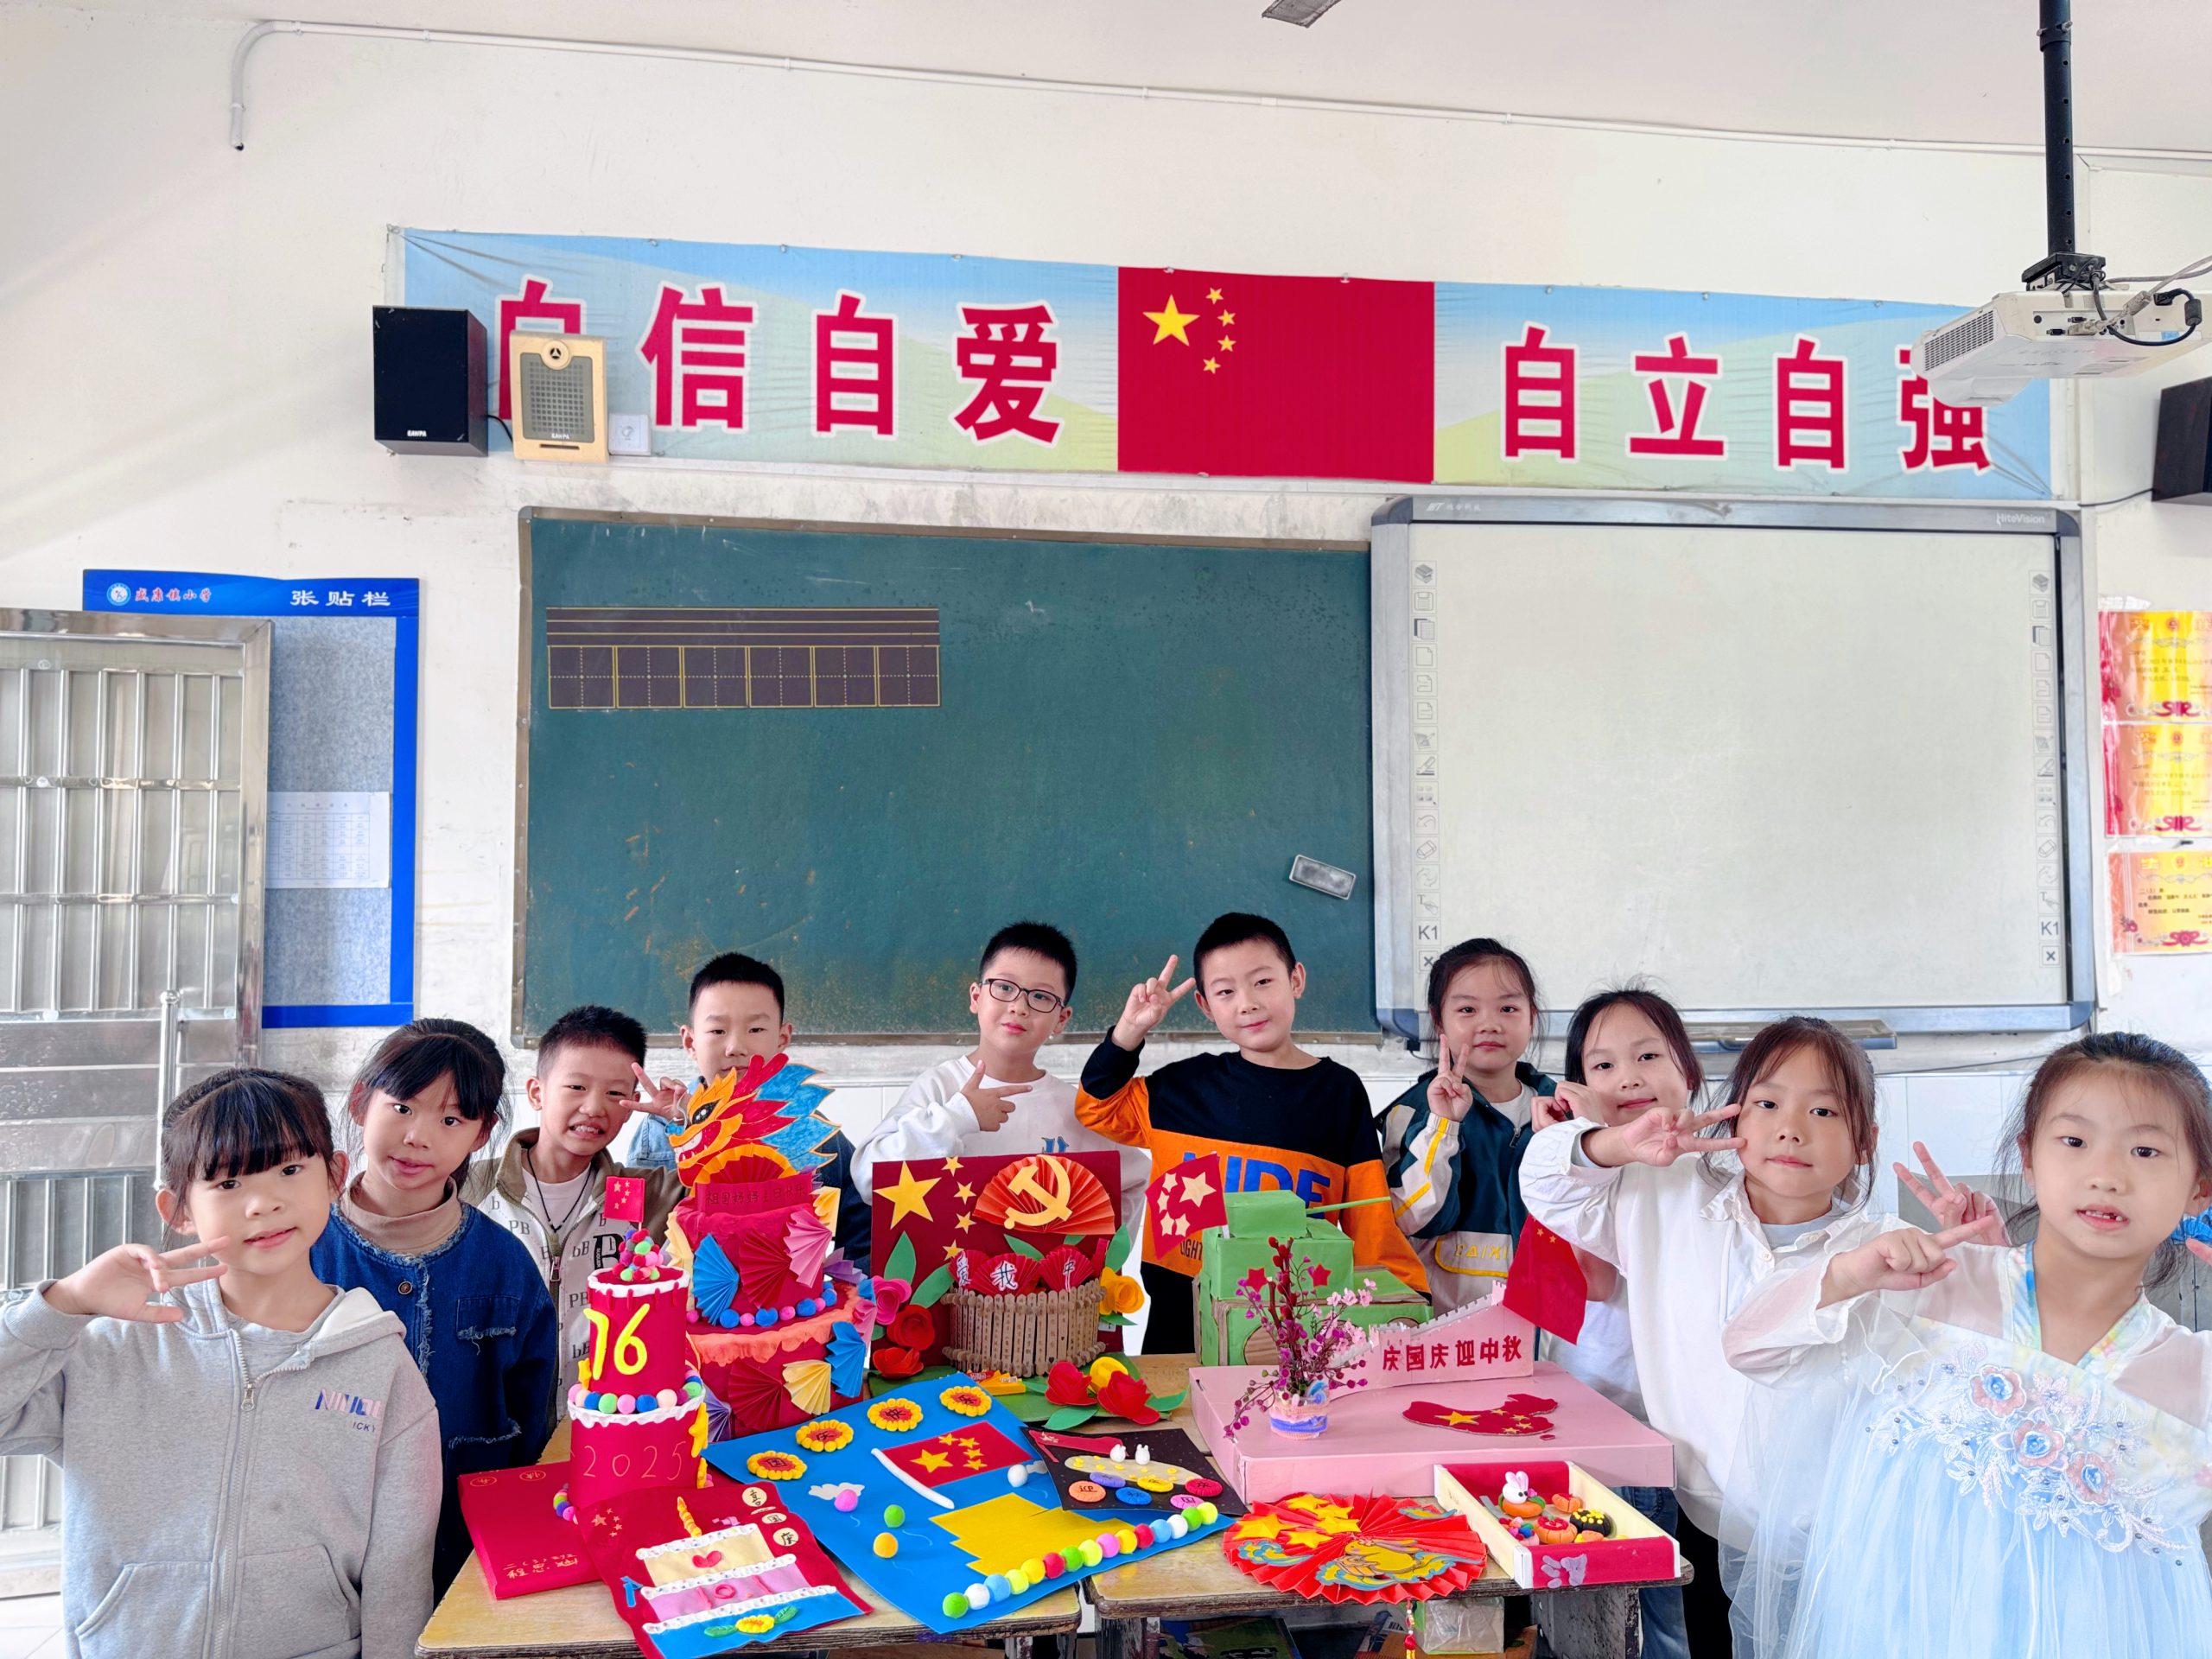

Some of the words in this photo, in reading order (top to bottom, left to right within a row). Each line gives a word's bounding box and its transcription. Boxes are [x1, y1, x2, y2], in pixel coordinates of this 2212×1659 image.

[289, 589, 391, 607] 张贴栏
[1418, 924, 1439, 942] K1
[2040, 921, 2060, 937] K1
[1184, 1152, 1331, 1219] IDE
[509, 1220, 531, 1236] PB
[572, 1241, 590, 1257] bB
[993, 1260, 1018, 1289] 我
[1382, 1335, 1522, 1372] 庆国庆迎中秋
[582, 1440, 687, 1481] 2025
